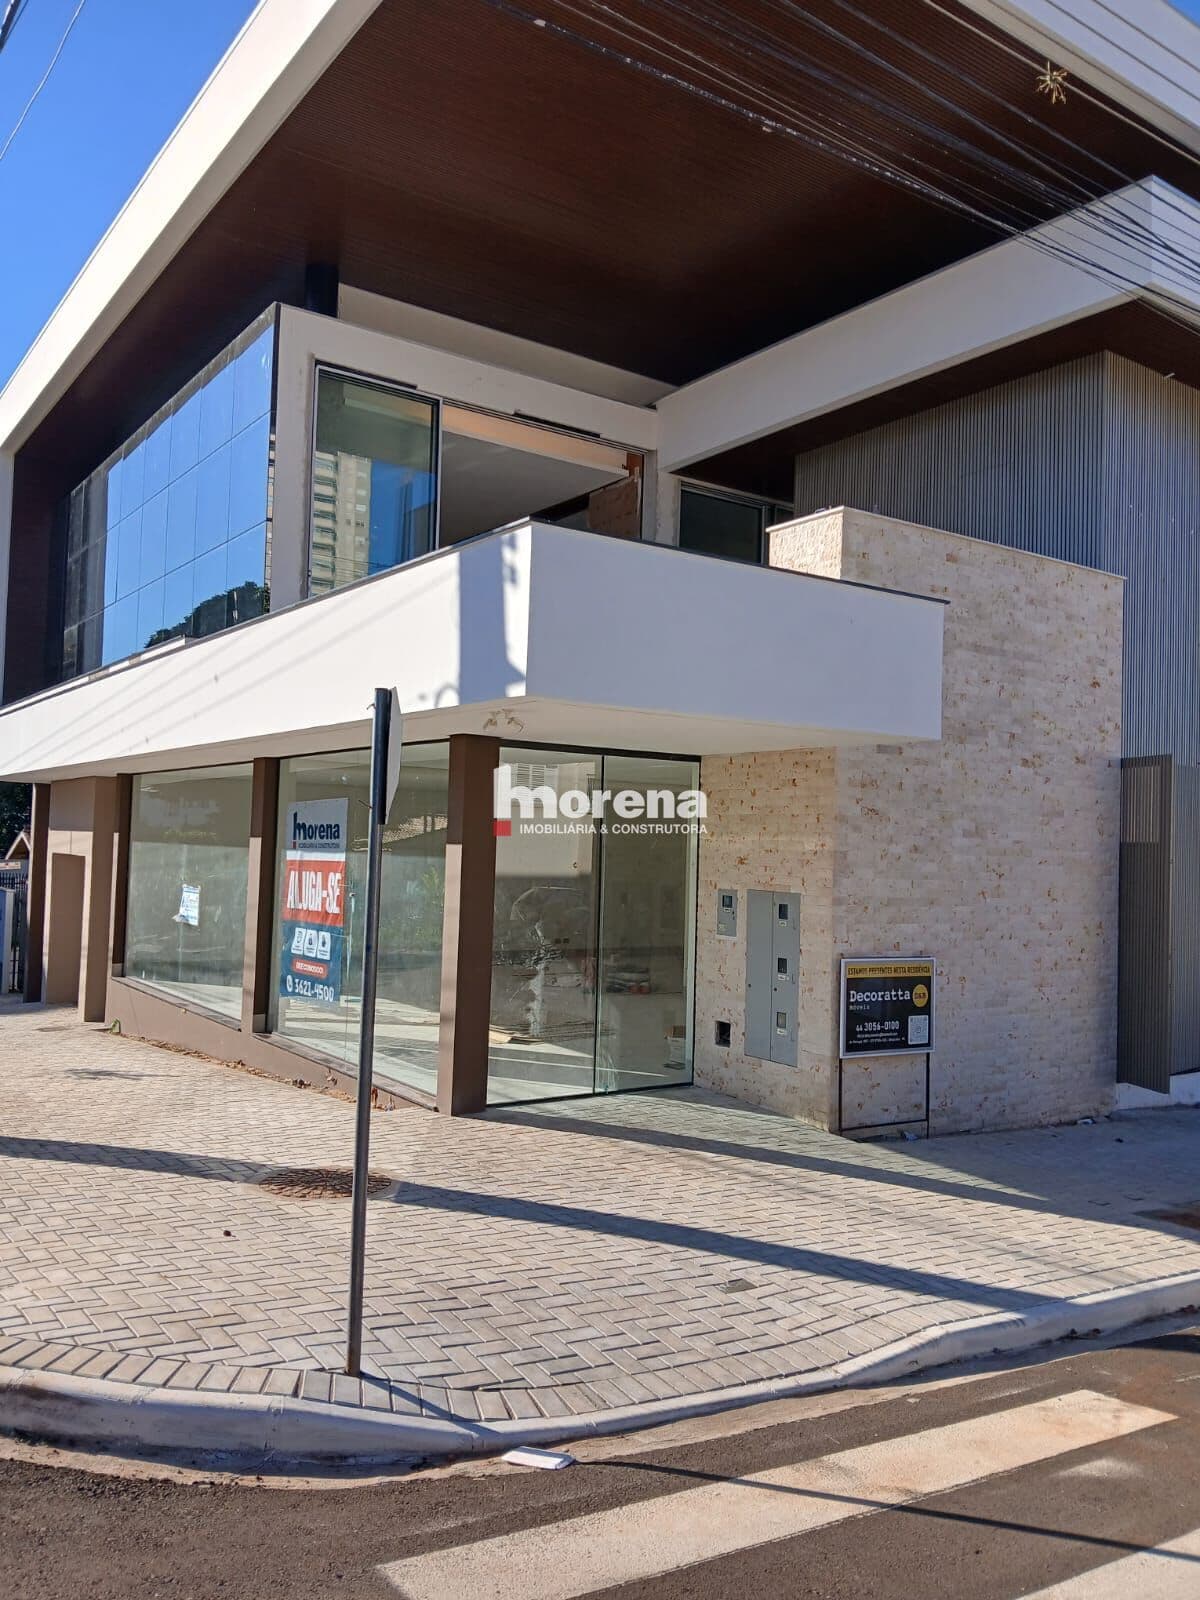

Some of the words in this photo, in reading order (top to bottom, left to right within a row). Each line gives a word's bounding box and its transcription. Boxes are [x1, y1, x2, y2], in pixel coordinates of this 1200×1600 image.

[293, 811, 340, 843] morena
[287, 870, 342, 914] ALUGA-SE
[294, 978, 335, 1003] 3621-4500
[849, 988, 911, 1002] Decoratta
[864, 1021, 899, 1031] 3056-0100
